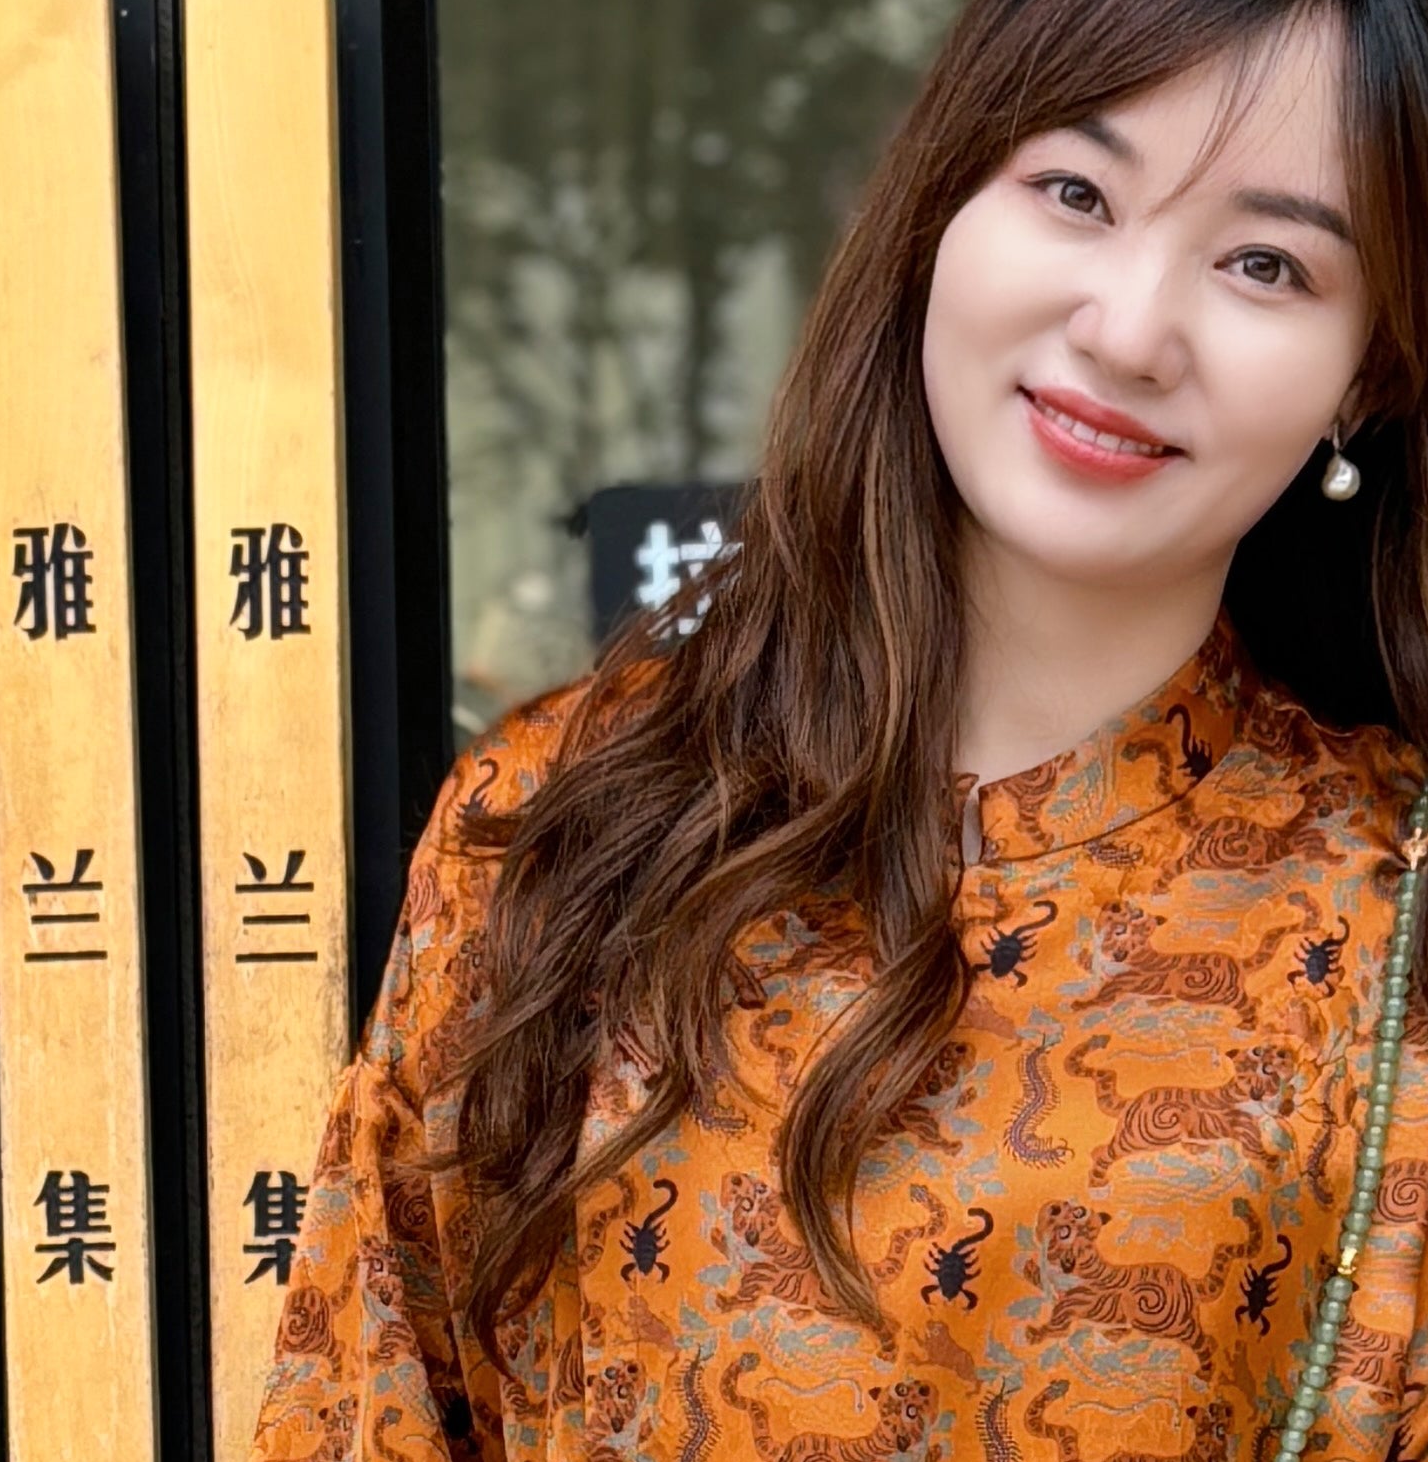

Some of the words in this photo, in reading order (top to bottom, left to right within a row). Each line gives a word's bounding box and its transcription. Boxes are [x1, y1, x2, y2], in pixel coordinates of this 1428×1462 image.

[11, 522, 116, 1285] 雅兰集
[229, 522, 318, 1285] 雅兰集
